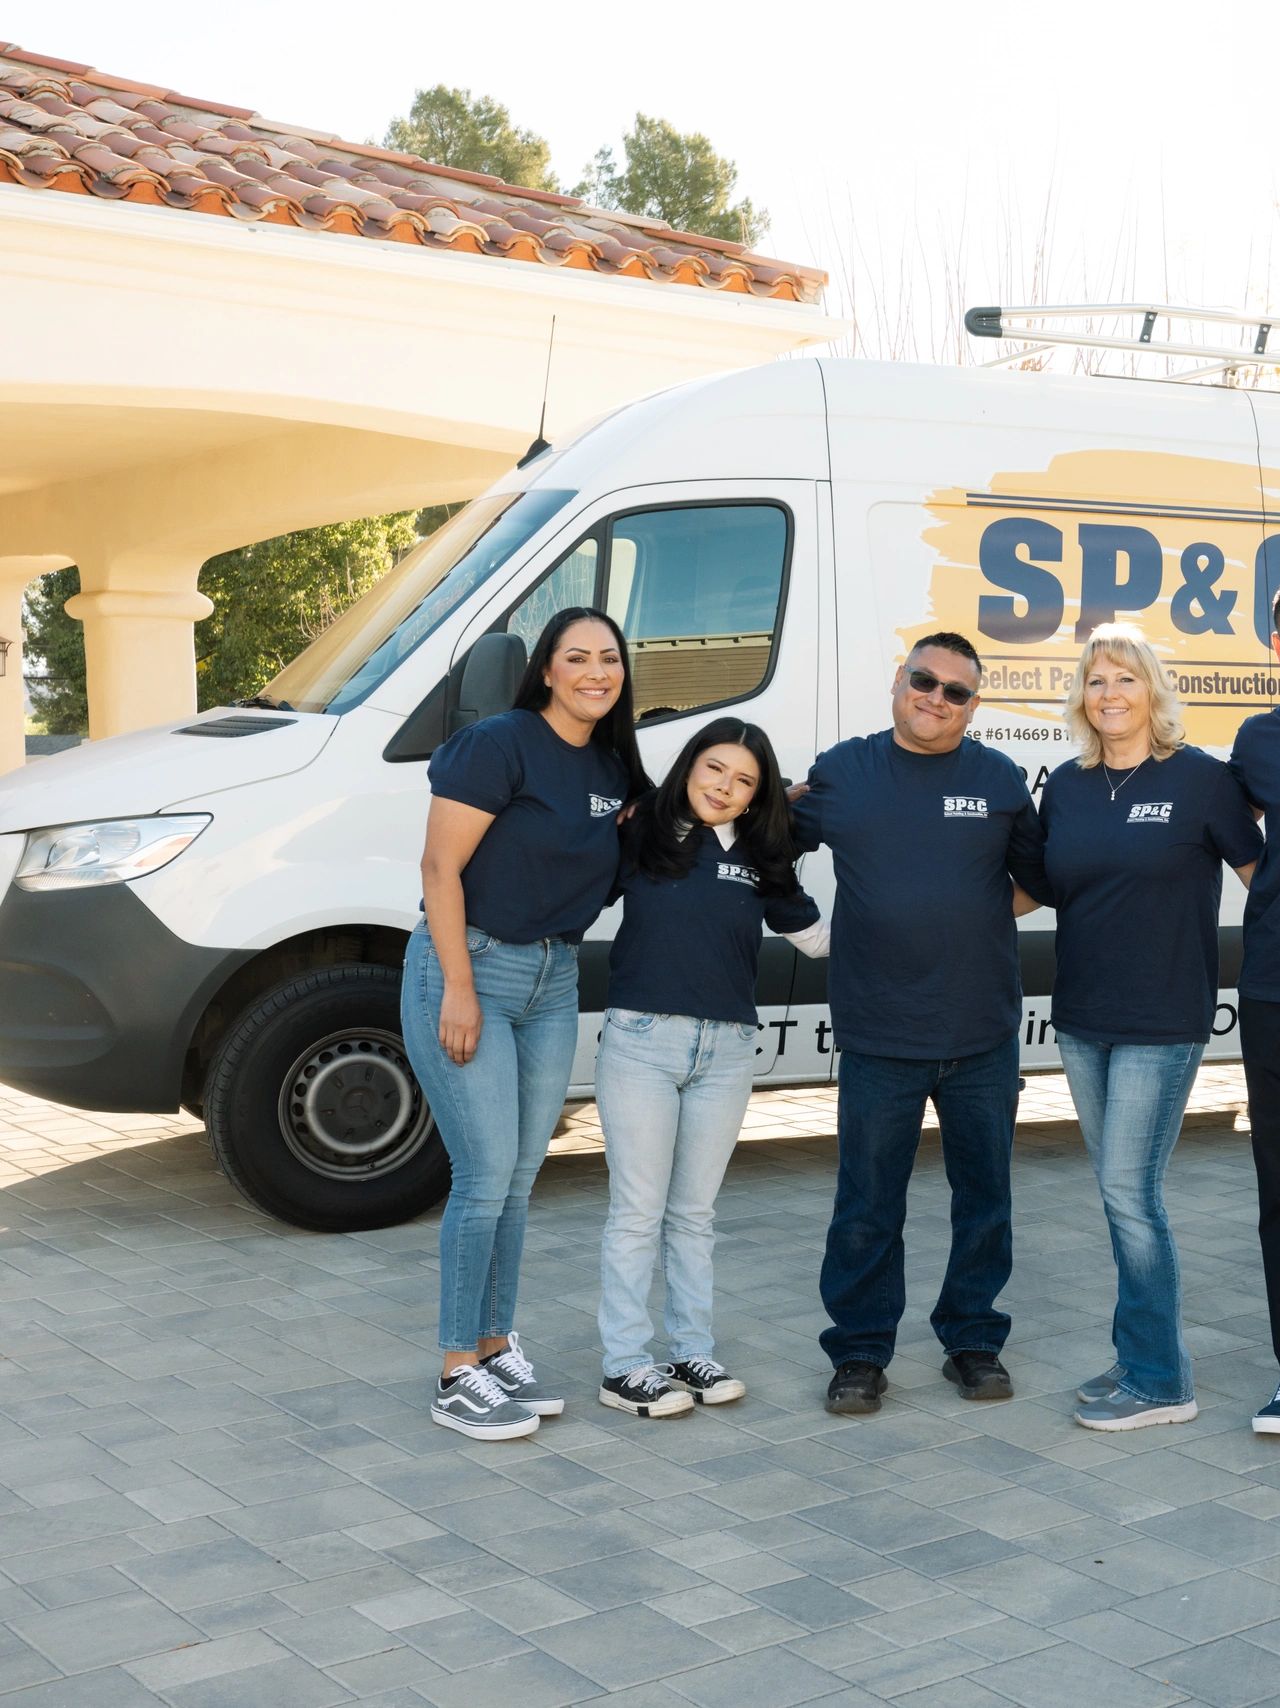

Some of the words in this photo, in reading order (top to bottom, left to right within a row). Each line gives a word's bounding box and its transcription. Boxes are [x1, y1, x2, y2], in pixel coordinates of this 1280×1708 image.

[980, 665, 1042, 690] Select
[986, 728, 1049, 740] #614669
[944, 798, 988, 812] SP&C
[1128, 804, 1172, 818] SP&C
